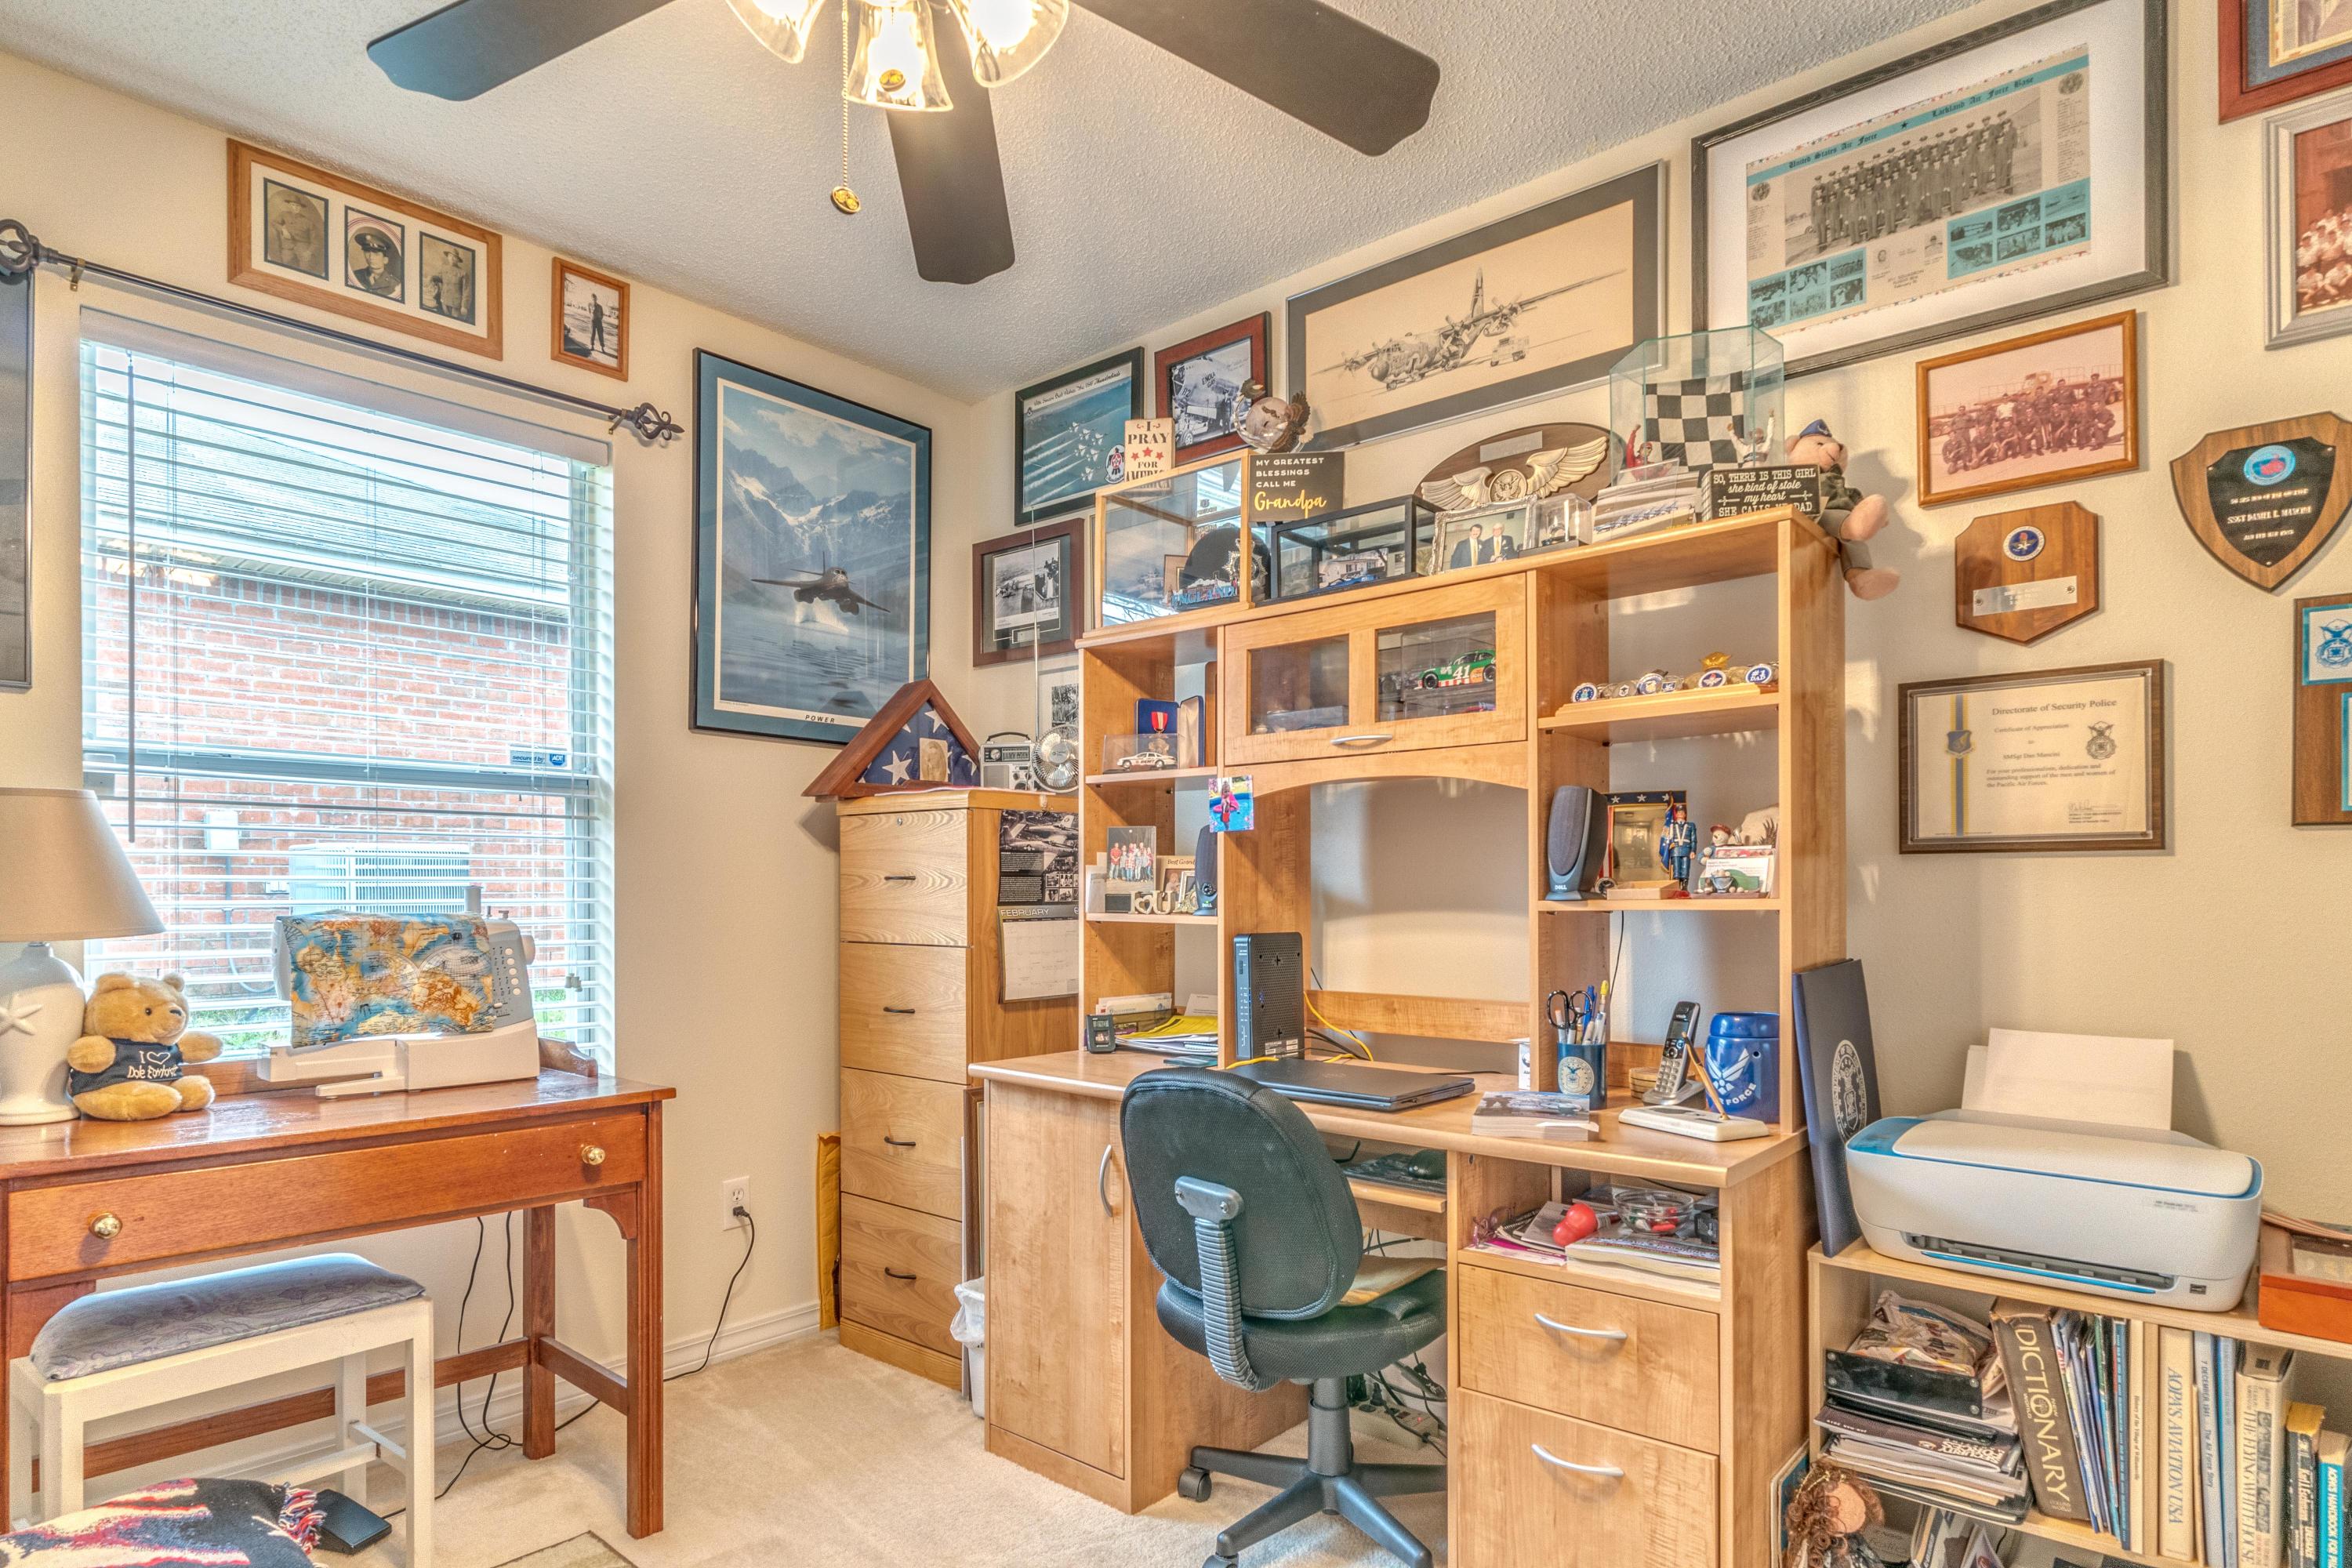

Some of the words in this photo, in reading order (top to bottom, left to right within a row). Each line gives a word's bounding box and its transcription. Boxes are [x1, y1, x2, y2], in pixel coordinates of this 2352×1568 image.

[1932, 101, 1965, 118] Lackland
[1969, 95, 1982, 105] Air
[1987, 86, 2009, 102] Force
[2014, 77, 2034, 89] Base
[1789, 157, 1811, 169] United
[1814, 147, 1838, 161] States
[1842, 141, 1853, 150] Air
[1857, 133, 1878, 147] Force
[1202, 372, 1216, 385] ENOLA
[1146, 421, 1151, 431] I
[1127, 432, 1170, 445] PRAY
[1273, 457, 1324, 466] GREATEST
[1713, 474, 1726, 485] SO,
[1728, 472, 1756, 483] THERE
[1759, 471, 1769, 481] IS
[1772, 470, 1792, 480] THIS
[1795, 468, 1816, 478] GIRL
[1728, 484, 1744, 493] she
[1744, 482, 1766, 492] kind
[1766, 480, 1779, 494] of
[1779, 480, 1802, 489] stole
[1254, 489, 1327, 519] Grandpa
[1744, 495, 1759, 505] my
[1759, 492, 1787, 502] heart
[1719, 506, 1737, 517] SHE
[1794, 502, 1813, 512] DAD
[1453, 665, 1471, 680] 41
[1992, 706, 2038, 716] Directorate
[2051, 701, 2087, 711] Security
[805, 714, 835, 724] POWER
[1994, 725, 2024, 734] Certificate
[2032, 724, 2070, 732] Appreciation
[1150, 890, 1173, 915] U
[1000, 908, 1050, 916] FEBRUARY
[139, 1051, 145, 1064] I
[127, 1065, 146, 1079] Dale
[1726, 1082, 1757, 1105] FORCE
[2168, 1367, 2183, 1419] AOPA'S
[2023, 1392, 2032, 1420] WORLD
[2051, 1398, 2060, 1417] NEW
[2014, 1327, 2071, 1502] DICTIONARY
[2201, 1367, 2210, 1402] DECEMBER
[2206, 1472, 2215, 1488] Story
[1938, 1446, 1999, 1464] SECURITY
[2168, 1419, 2183, 1494] AVIATION
[2168, 1494, 2183, 1524] USA
[2328, 1494, 2337, 1538] HANDBOOK
[2328, 1538, 2337, 1554] FOR
